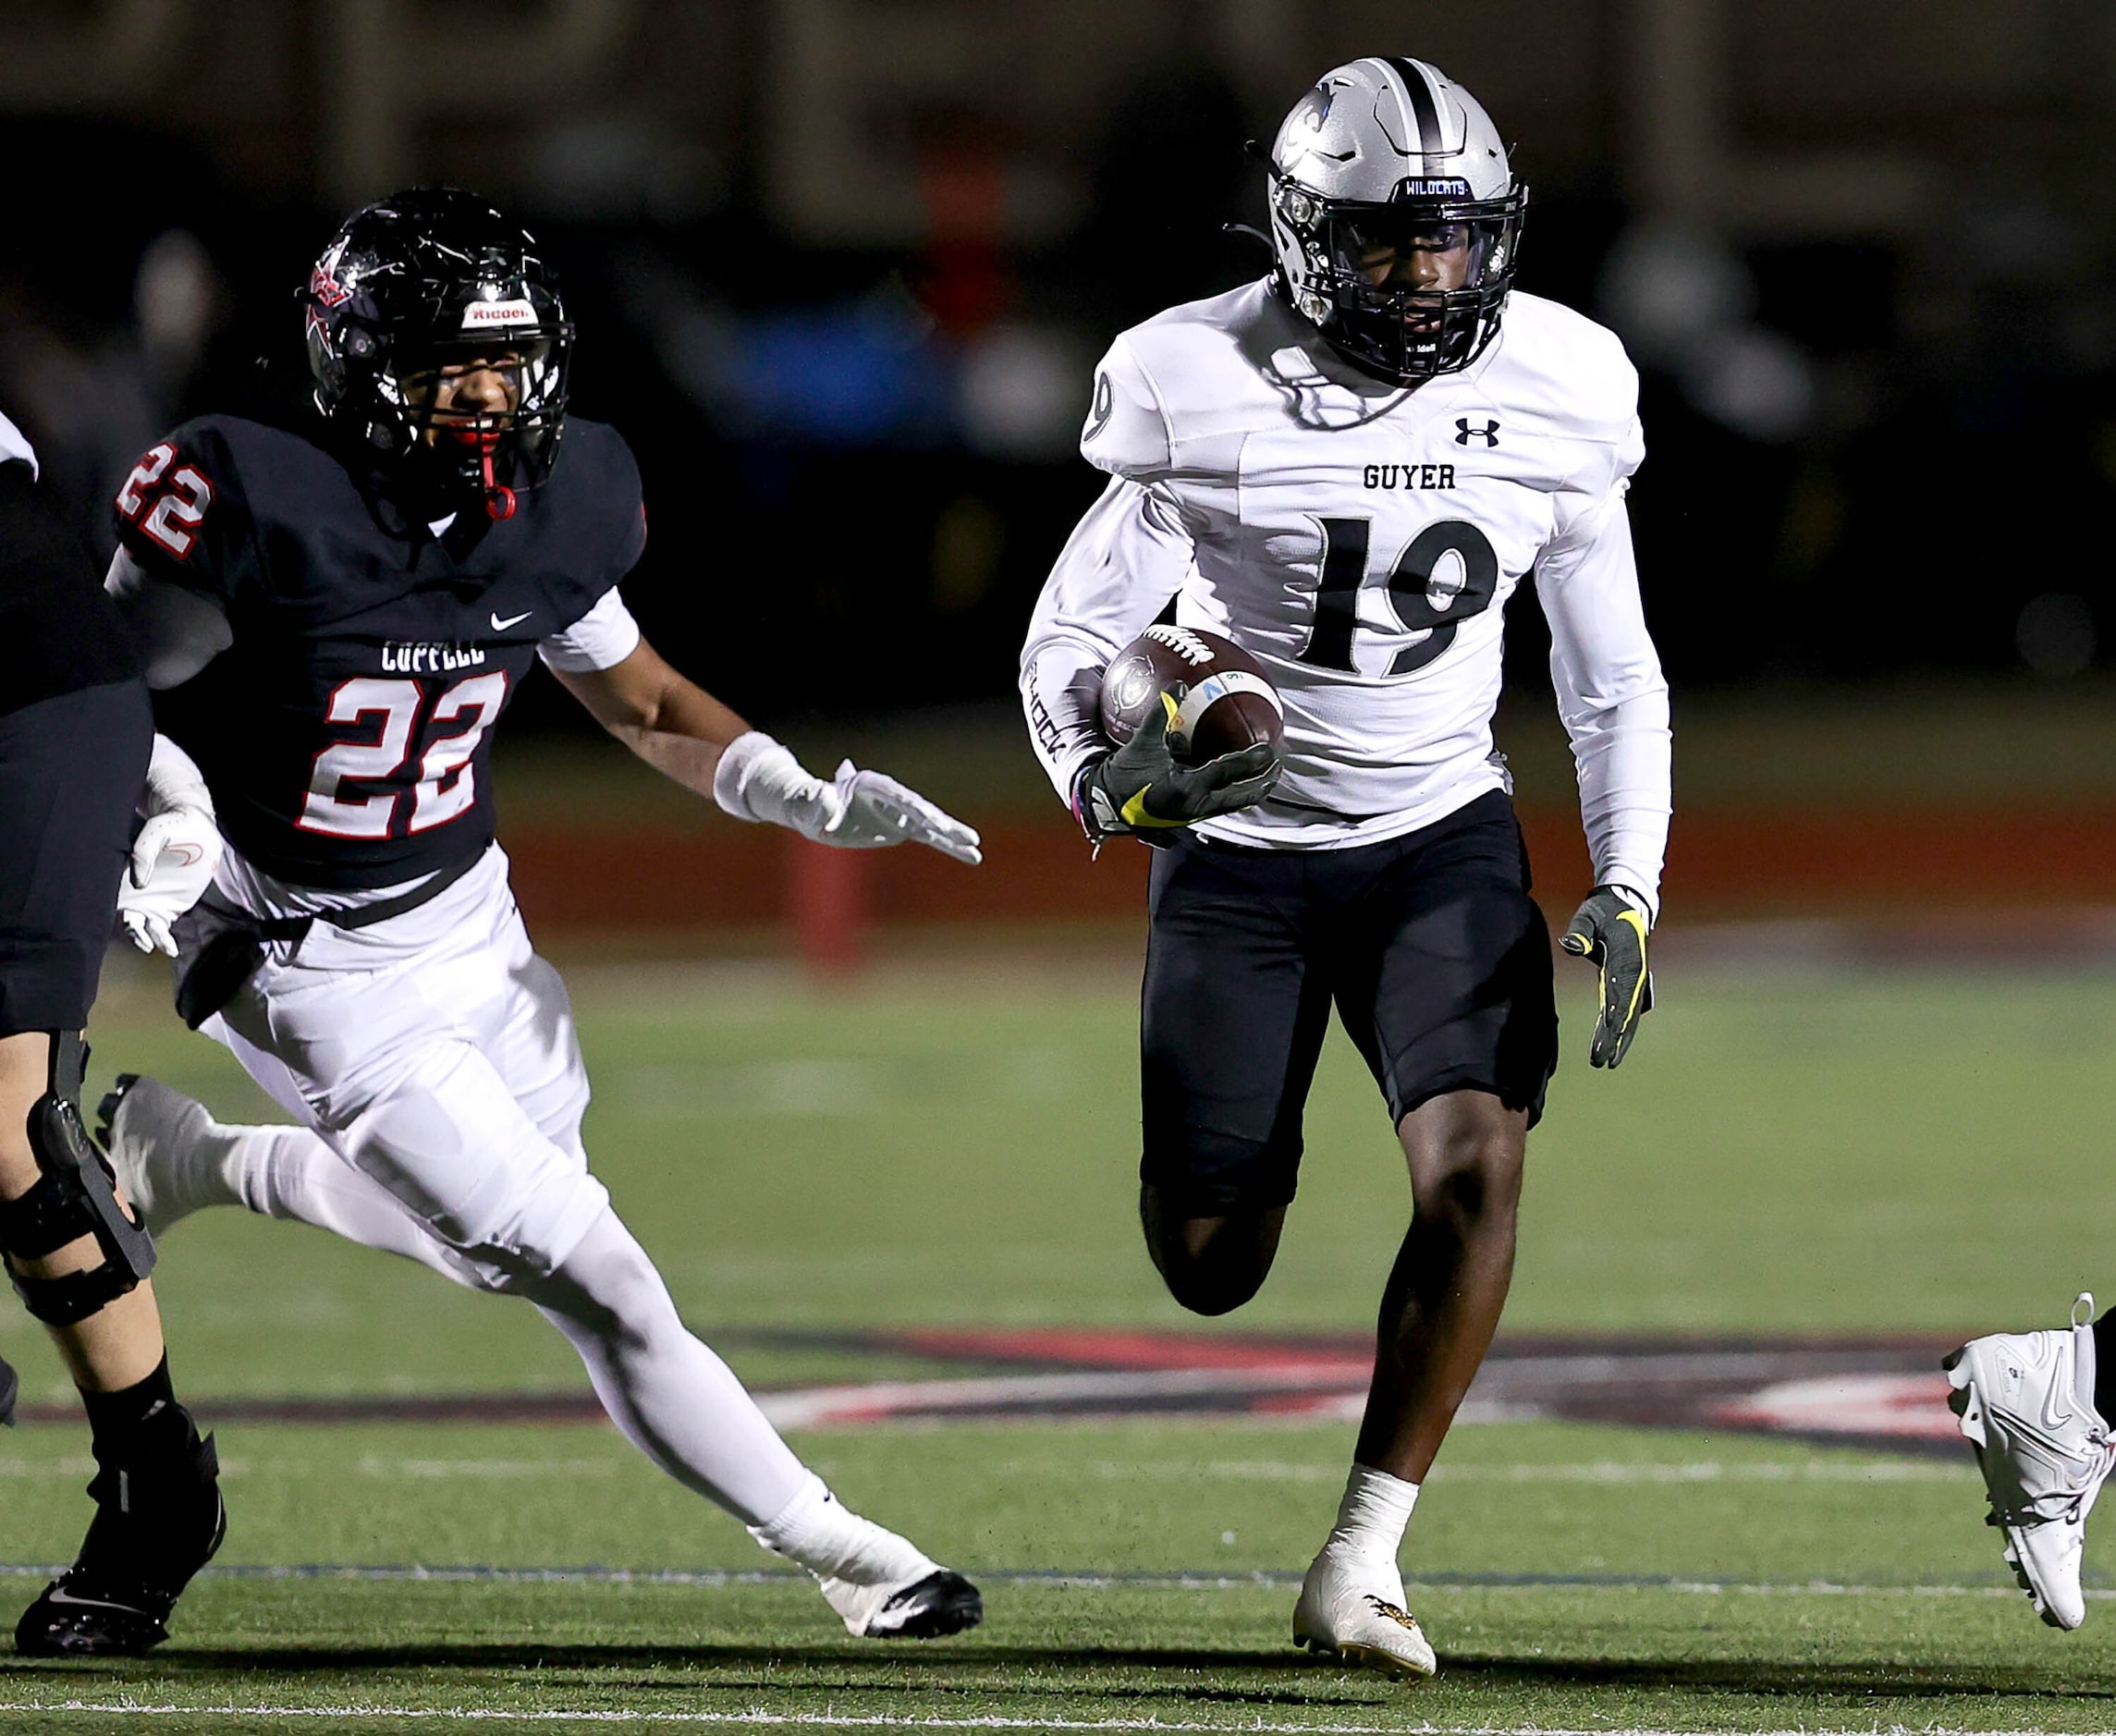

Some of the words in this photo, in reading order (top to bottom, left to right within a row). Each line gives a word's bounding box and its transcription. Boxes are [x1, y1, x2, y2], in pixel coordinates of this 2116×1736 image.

[1406, 179, 1463, 196] WILDCATS
[114, 442, 217, 560] 22
[1363, 464, 1456, 490] GUYER
[1293, 513, 1498, 679] 19
[293, 668, 509, 841] 22
